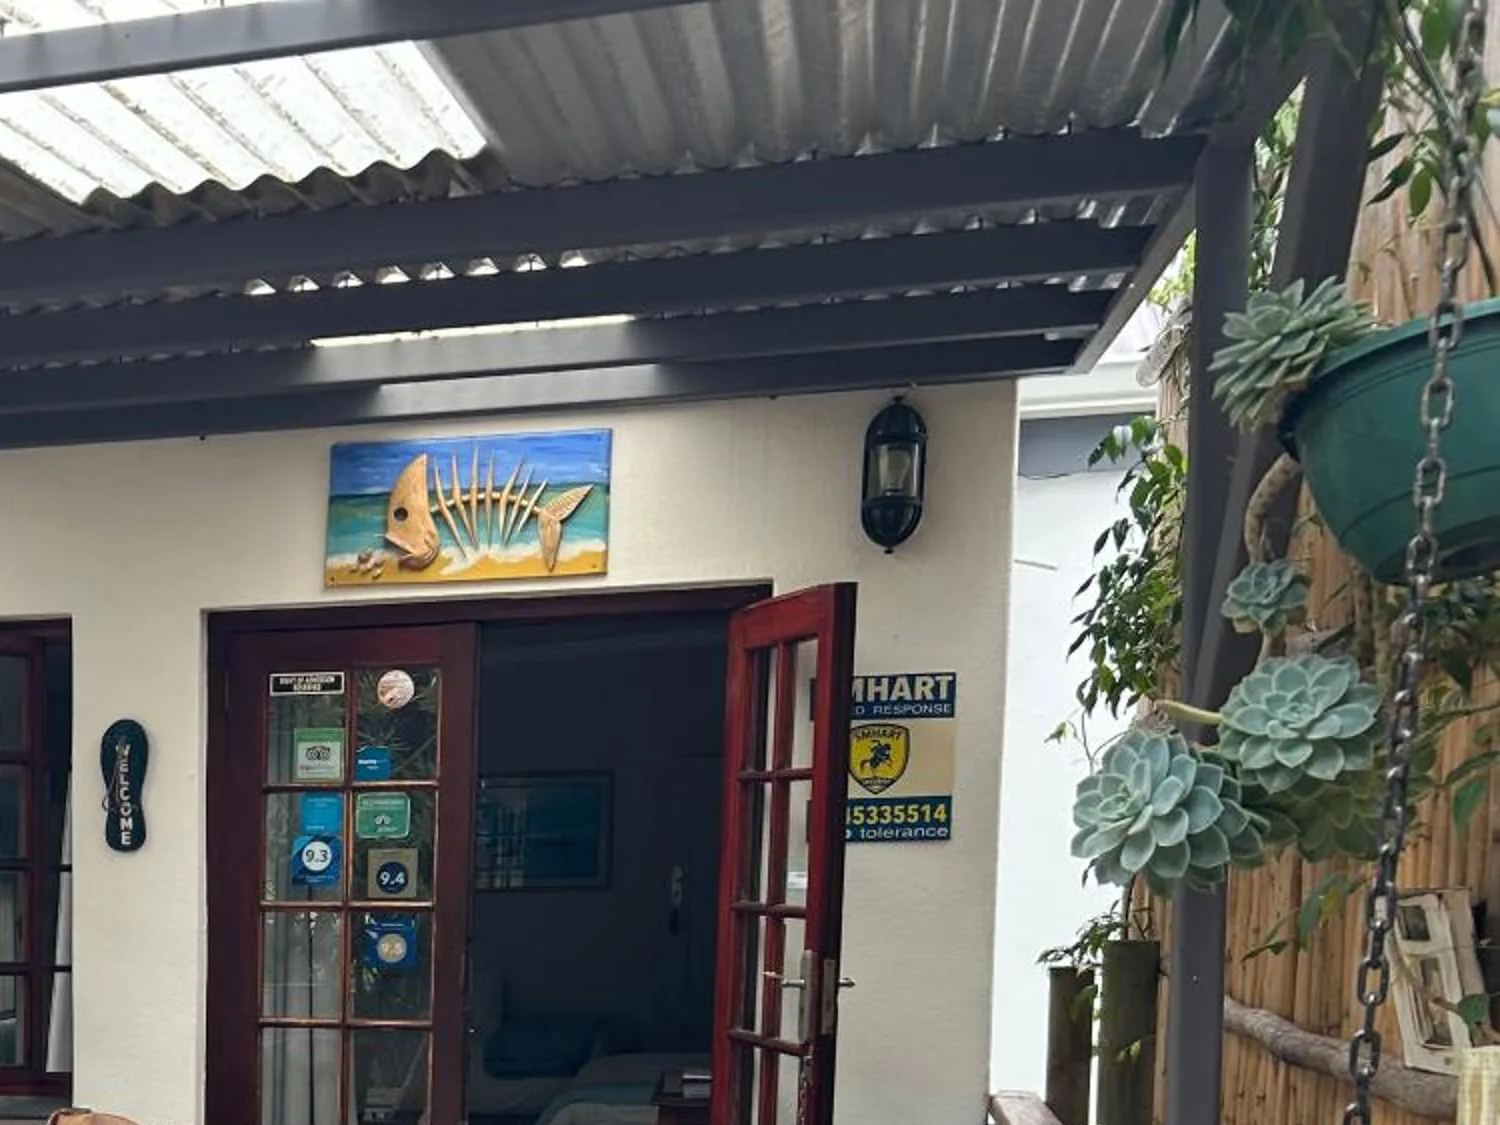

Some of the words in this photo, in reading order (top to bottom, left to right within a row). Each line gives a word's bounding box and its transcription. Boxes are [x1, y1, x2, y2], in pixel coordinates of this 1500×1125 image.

[873, 703, 952, 715] RESPONSE
[115, 743, 133, 845] WELCOME
[860, 826, 949, 839] tolerance
[305, 849, 329, 863] 9.3
[379, 871, 405, 884] 9.4
